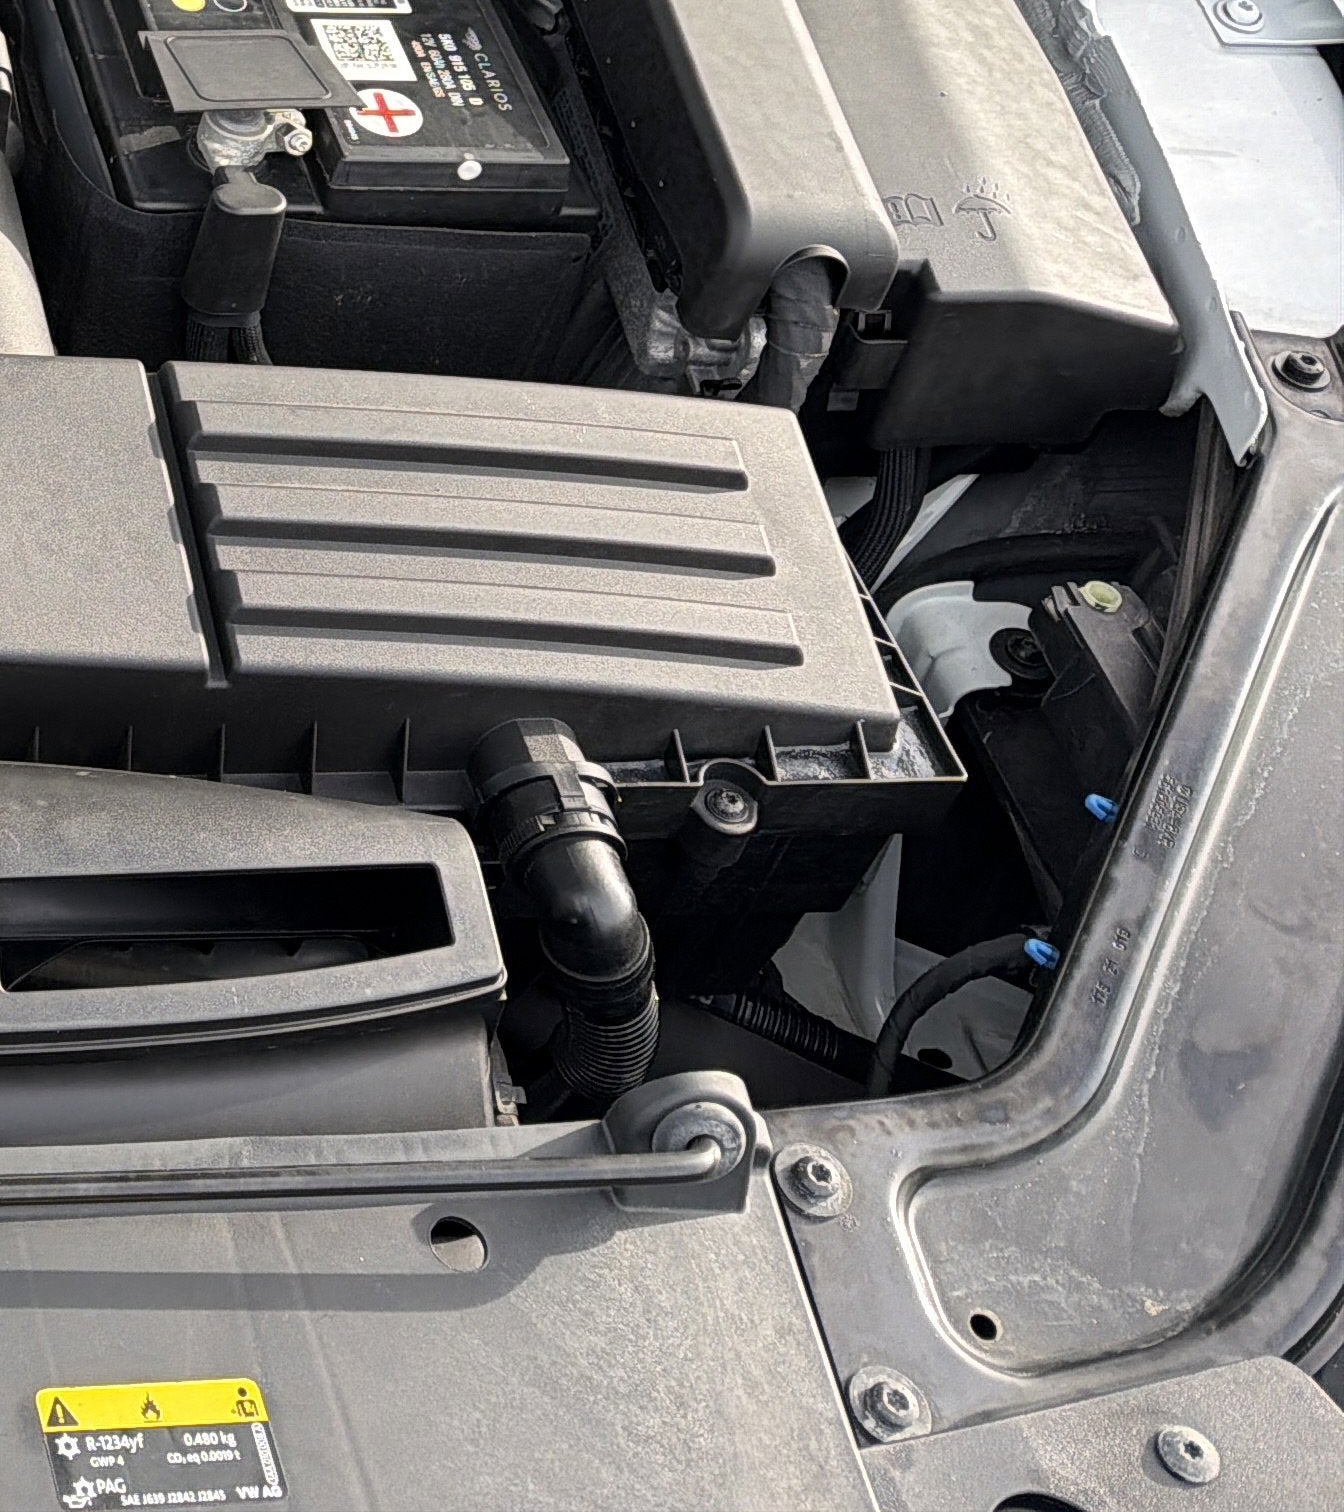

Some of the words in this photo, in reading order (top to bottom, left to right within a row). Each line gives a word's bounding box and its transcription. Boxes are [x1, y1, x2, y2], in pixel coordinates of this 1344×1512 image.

[420, 33, 438, 48] 12V
[474, 53, 512, 111] CLARIOS
[86, 1433, 144, 1453] R-1234yf
[183, 1432, 218, 1447] 0.480
[220, 1431, 237, 1448] kg
[90, 1456, 115, 1468] GWP
[118, 1455, 125, 1466] 4
[96, 1478, 126, 1494] PAG
[236, 1486, 259, 1499] VW
[263, 1485, 283, 1498] AG
[120, 1495, 140, 1506] SAE
